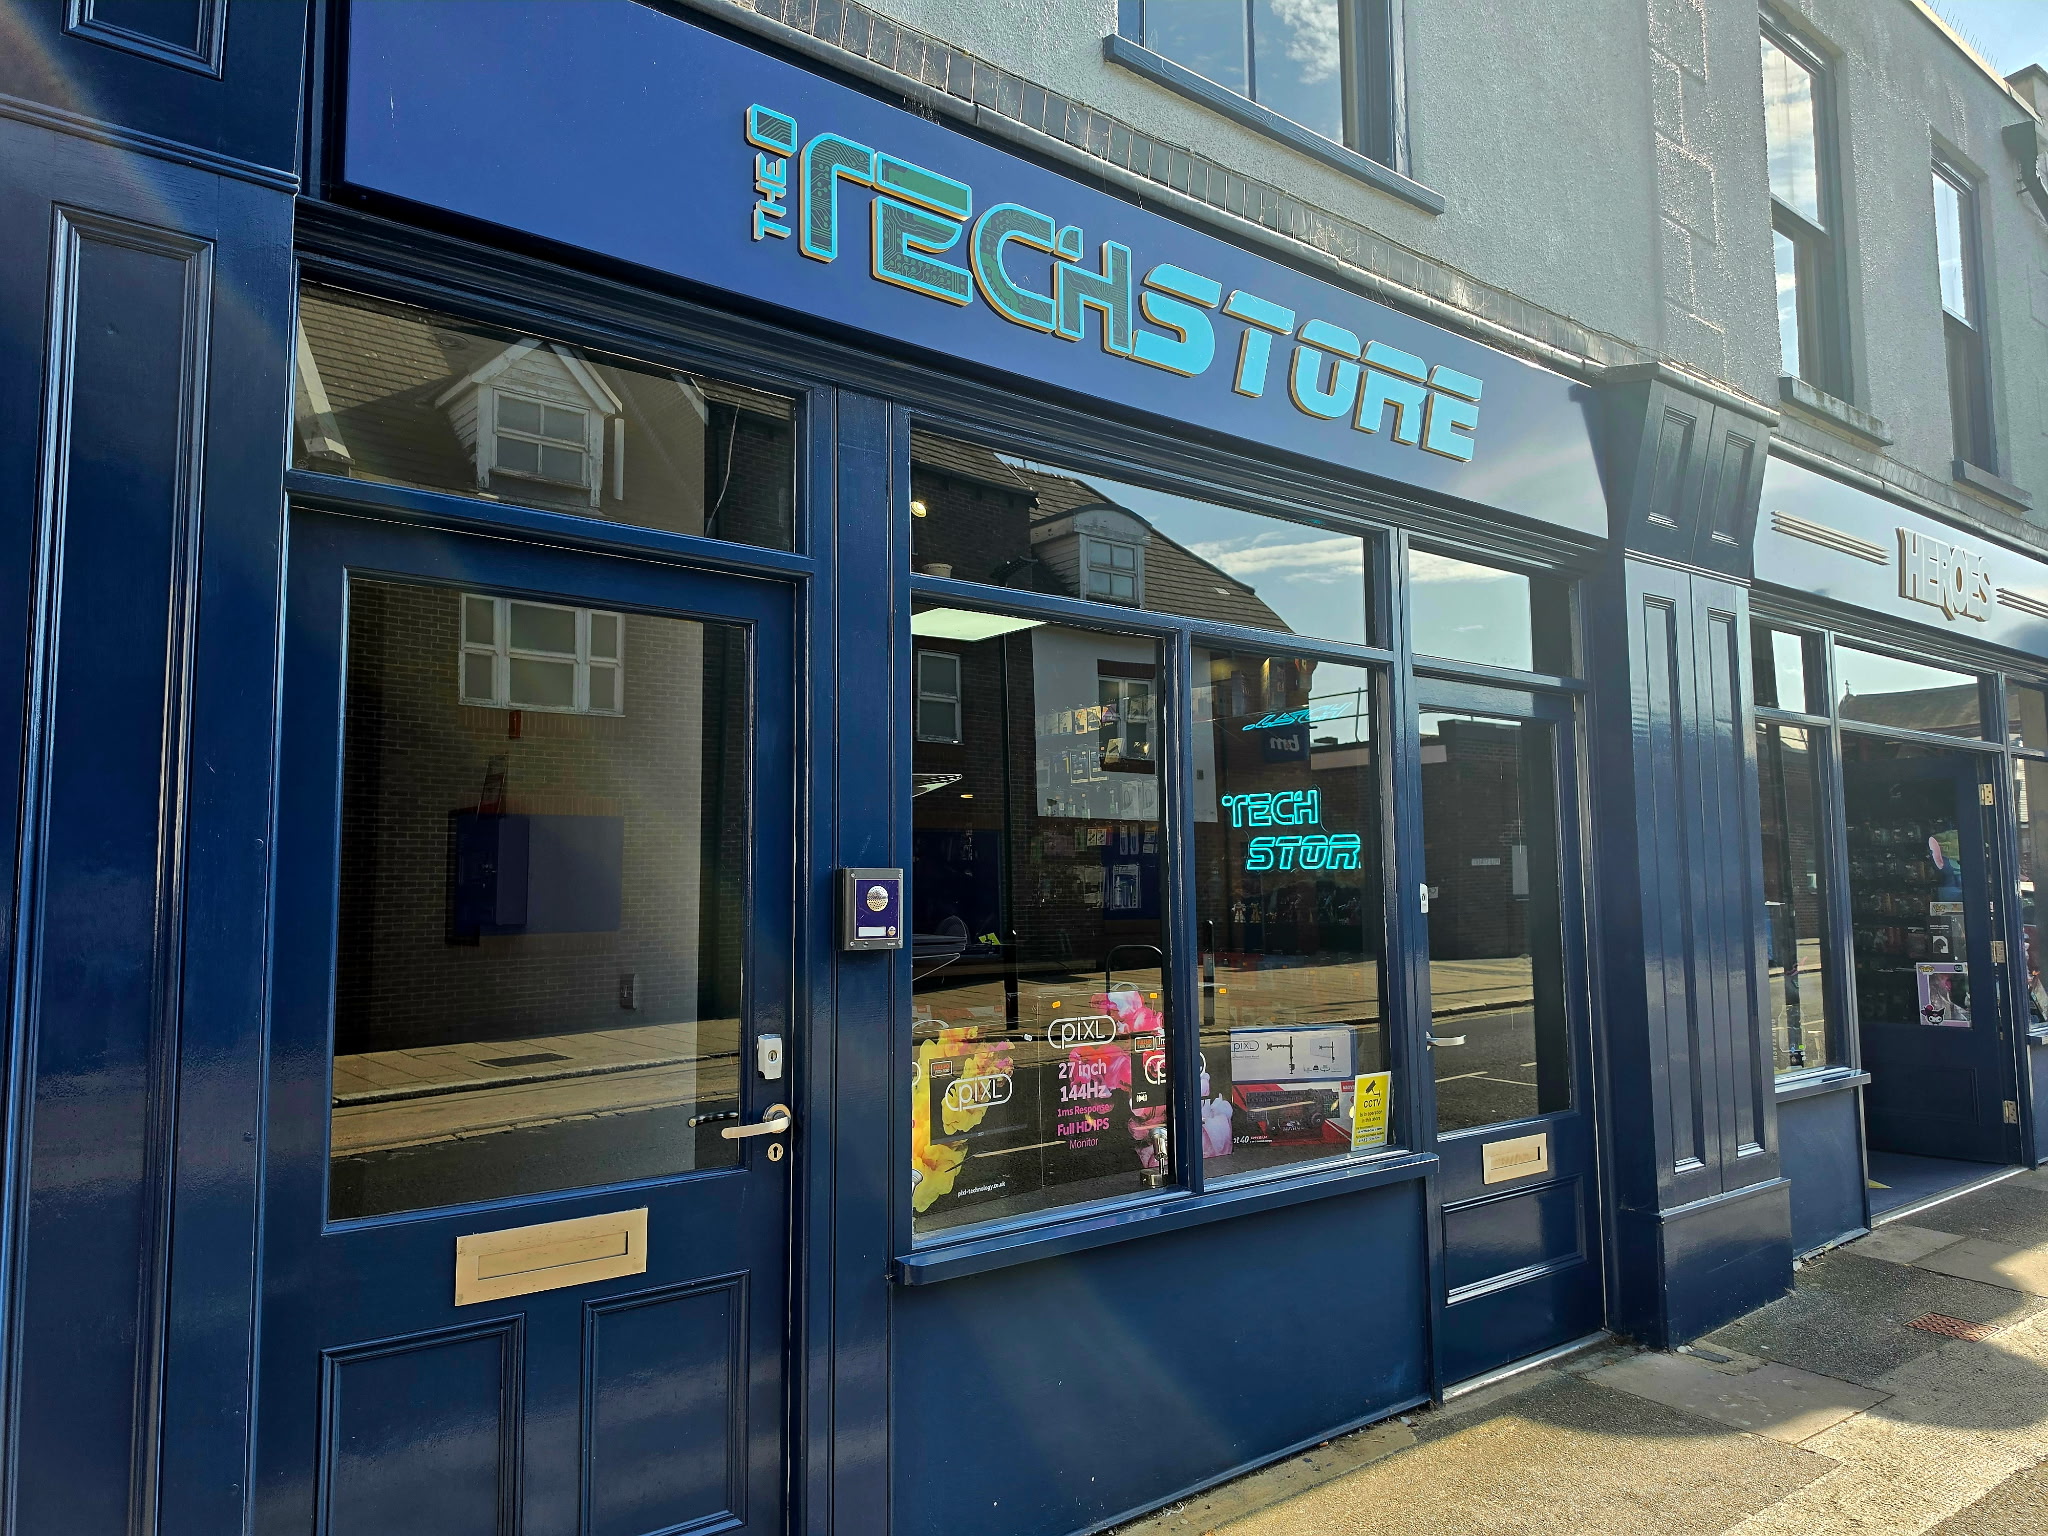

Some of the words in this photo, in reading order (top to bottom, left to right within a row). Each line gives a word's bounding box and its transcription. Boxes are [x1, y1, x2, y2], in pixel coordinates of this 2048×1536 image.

[753, 152, 792, 241] THE
[1895, 527, 1993, 622] HEROES
[1222, 789, 1319, 828] TECH
[1246, 833, 1362, 870] STOR
[1058, 1062, 1076, 1079] 27
[1079, 1059, 1107, 1077] inch
[1060, 1081, 1107, 1102] 144Hz
[1057, 1108, 1074, 1117] 1ms
[1074, 1103, 1110, 1116] Response
[1363, 1098, 1382, 1108] CCTV
[1057, 1122, 1075, 1137] Full
[1076, 1120, 1092, 1134] HD
[1069, 1138, 1099, 1150] Monitor
